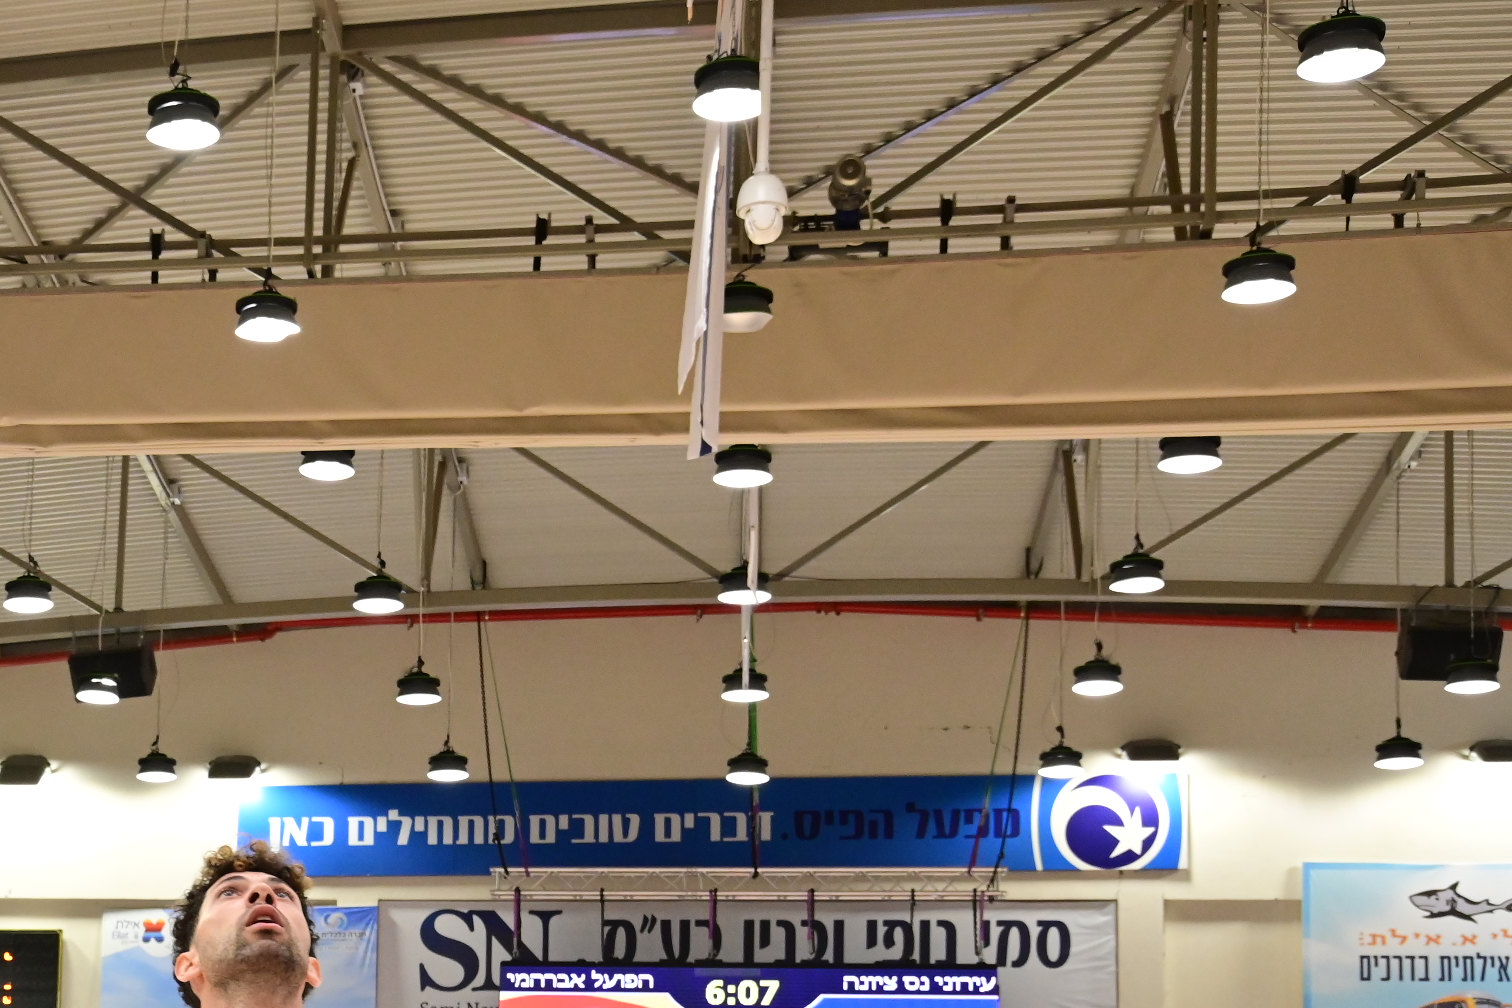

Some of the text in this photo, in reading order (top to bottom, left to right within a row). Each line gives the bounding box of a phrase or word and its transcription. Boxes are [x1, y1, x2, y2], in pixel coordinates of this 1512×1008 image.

[268, 815, 335, 853] כאן
[348, 809, 515, 847] מתחילים
[529, 813, 641, 844] טובים
[654, 810, 774, 843] דברים
[905, 802, 1021, 840] מפעל
[420, 908, 563, 992] SN
[981, 919, 1071, 969] סמי
[506, 969, 655, 990] הפועל אברהמי
[842, 974, 997, 993] עירוני נס ציונה
[1359, 954, 1431, 982] בדרכים
[704, 979, 781, 1007] 6:07
